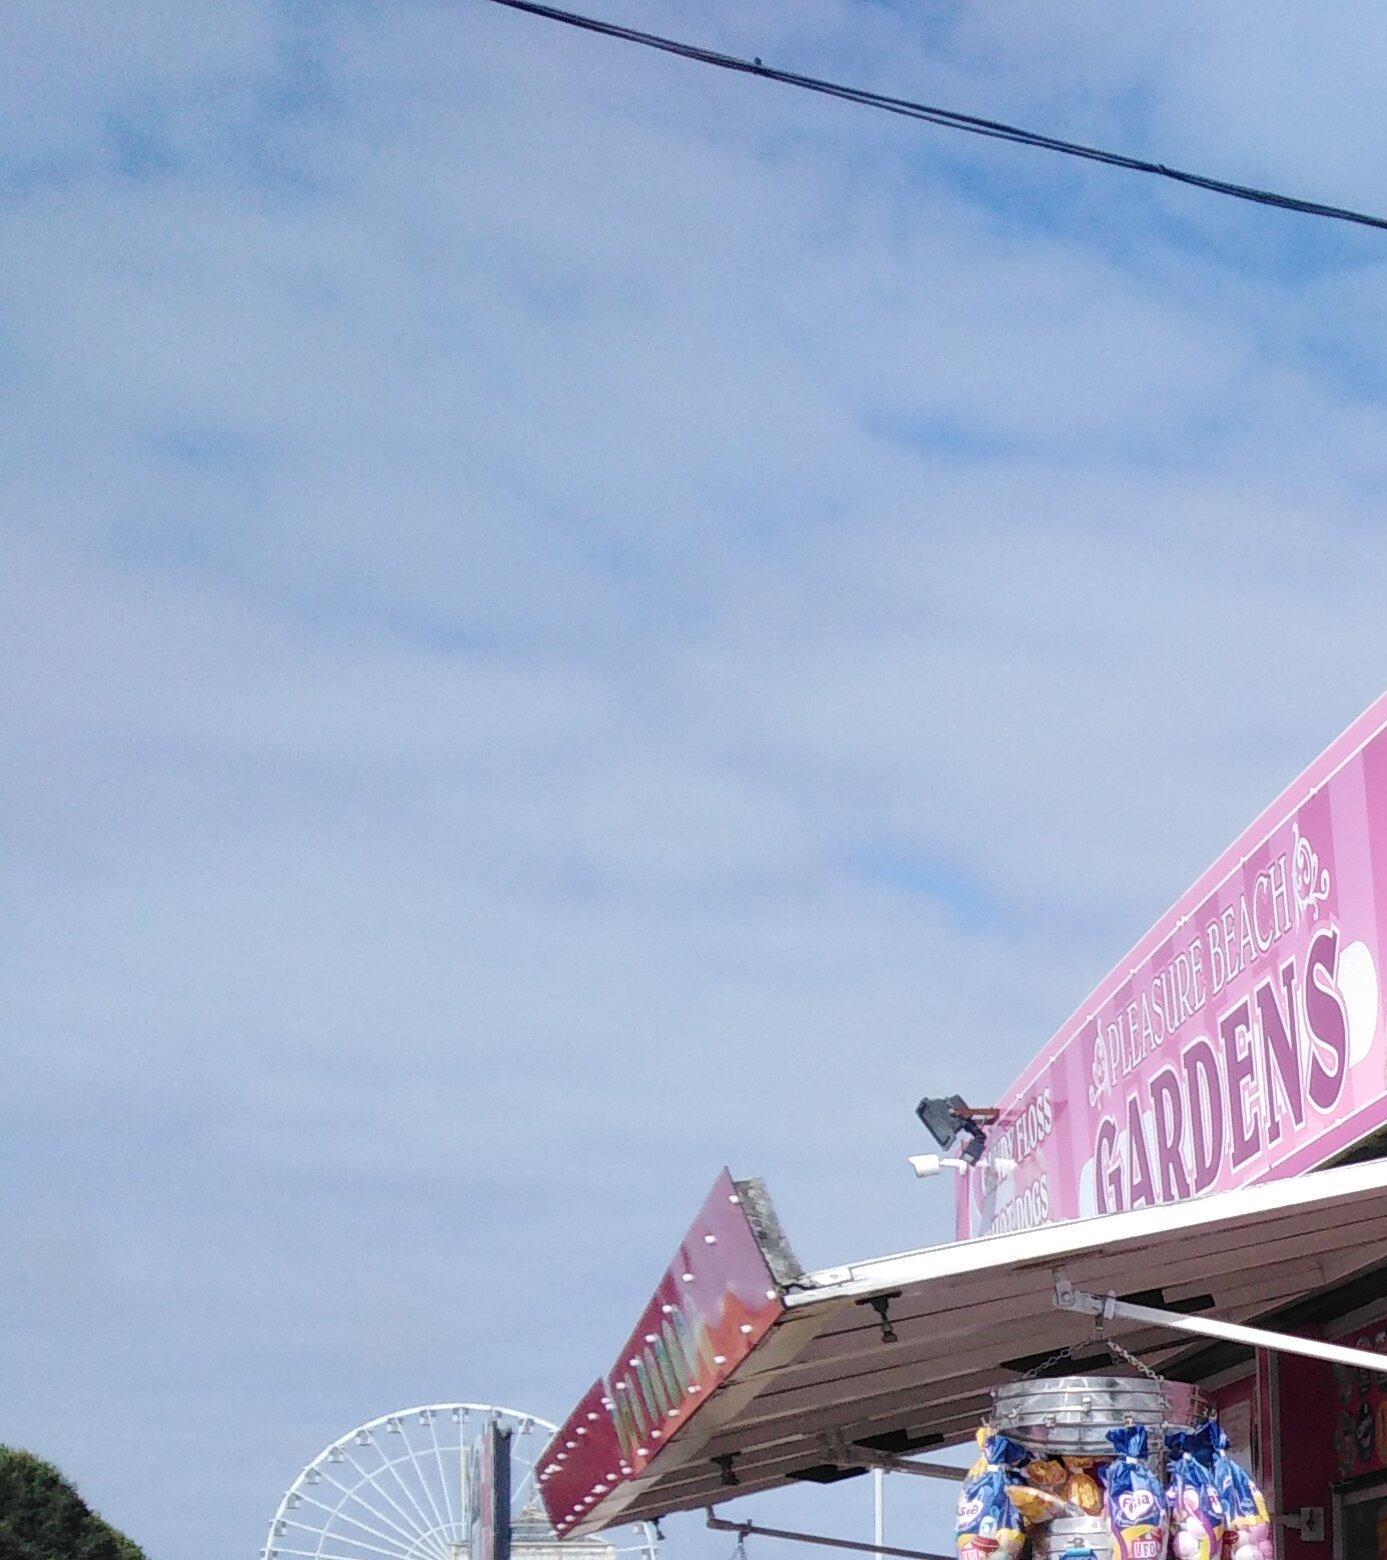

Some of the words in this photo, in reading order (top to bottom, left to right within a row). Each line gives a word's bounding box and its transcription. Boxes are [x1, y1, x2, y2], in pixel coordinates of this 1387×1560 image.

[1096, 920, 1348, 1214] GARDENS
[1107, 936, 1208, 1086] PLEASURE
[1207, 856, 1293, 996] BEACH
[1015, 1088, 1052, 1162] FLOSS
